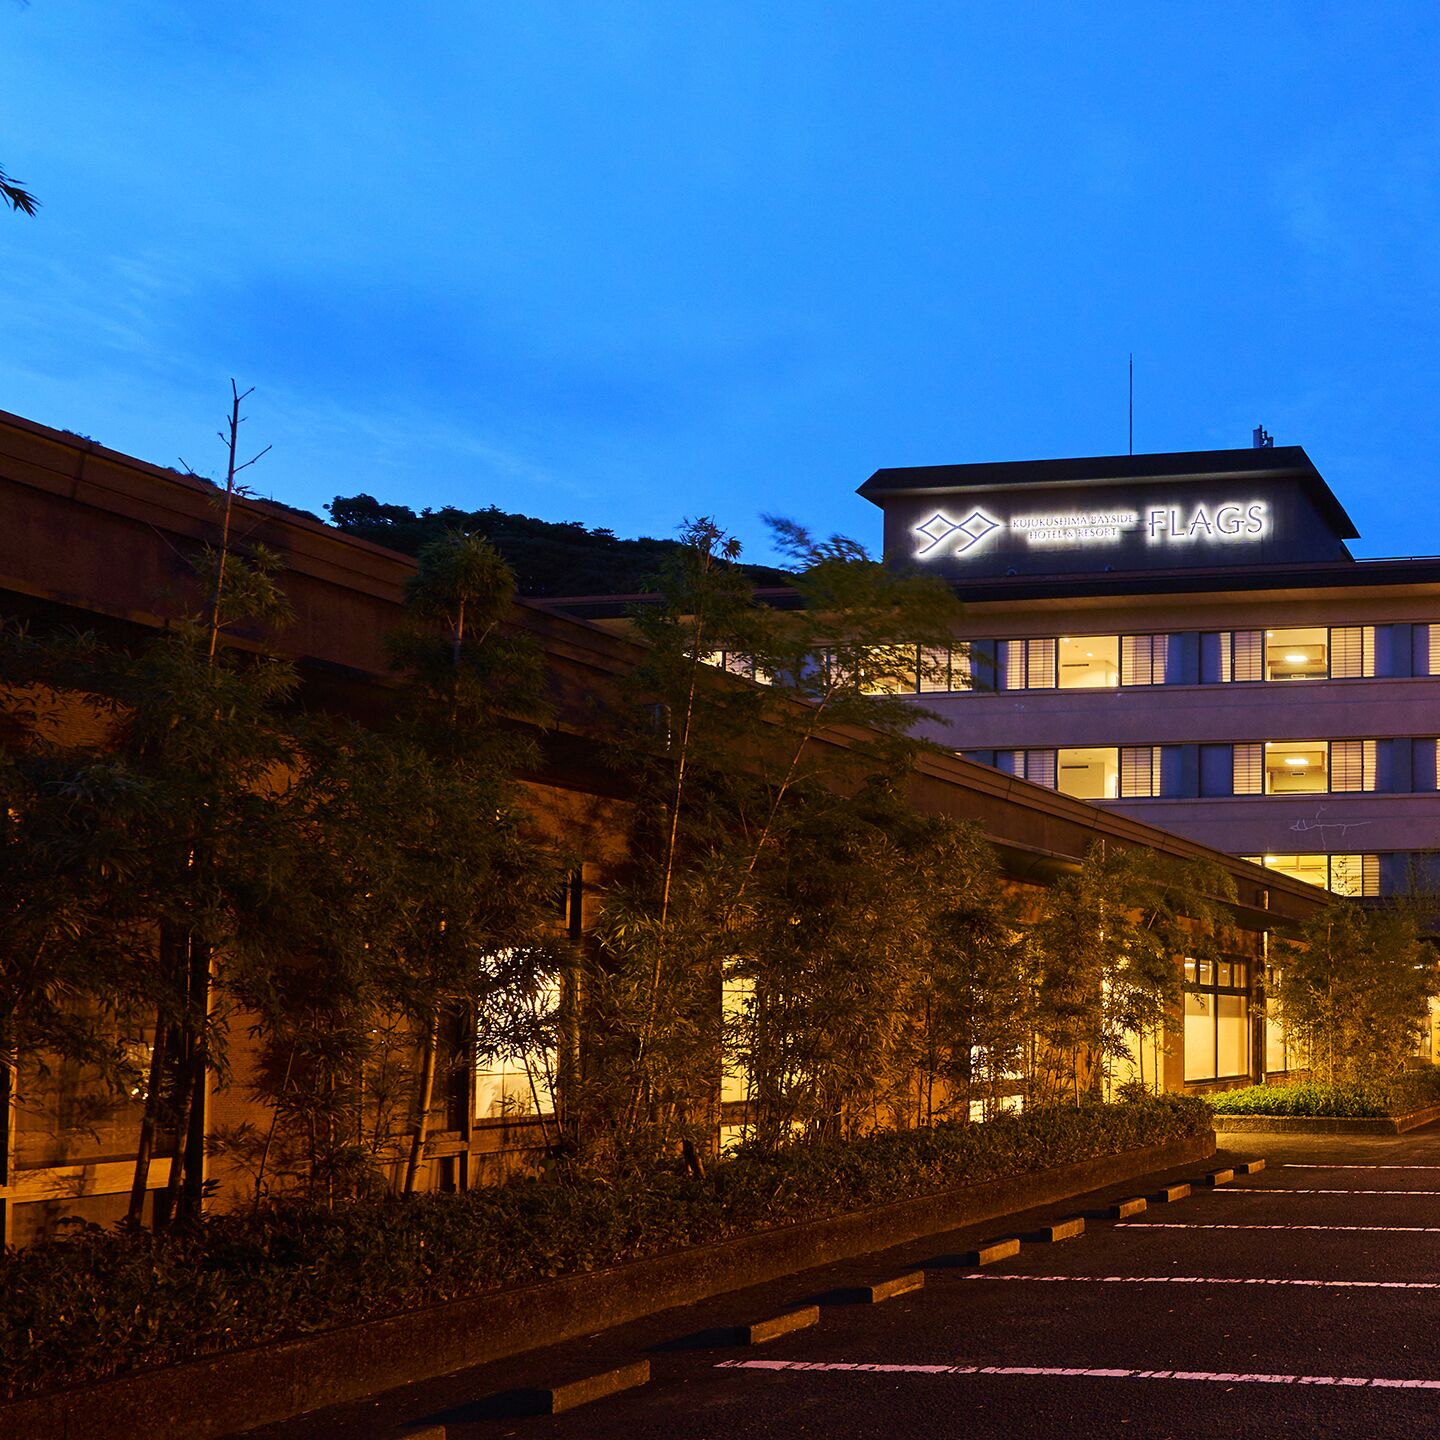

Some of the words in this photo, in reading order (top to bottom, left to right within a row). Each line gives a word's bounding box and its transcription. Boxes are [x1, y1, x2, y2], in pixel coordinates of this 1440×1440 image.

[1013, 515, 1088, 528] KUJUKUSHIMA
[1090, 513, 1134, 525] BAYSIDE
[1148, 505, 1263, 537] FLAGS
[1029, 530, 1062, 540] HOTEL
[1066, 530, 1074, 538] &
[1077, 527, 1117, 538] RESORT
